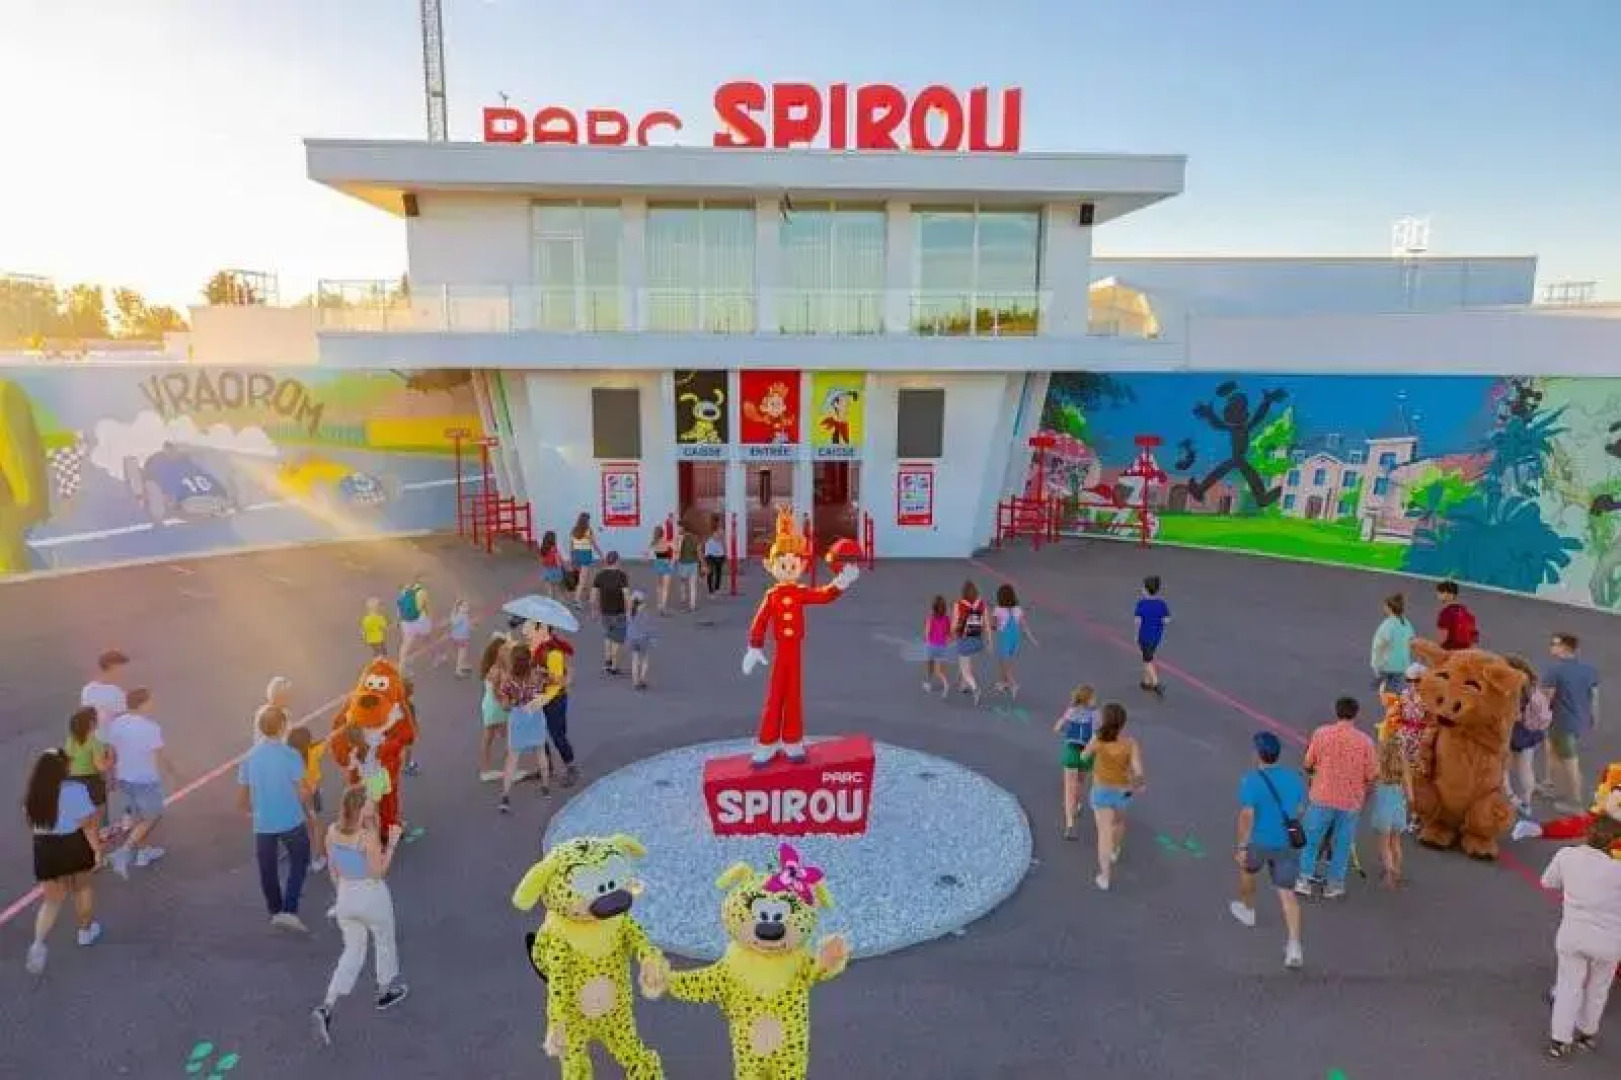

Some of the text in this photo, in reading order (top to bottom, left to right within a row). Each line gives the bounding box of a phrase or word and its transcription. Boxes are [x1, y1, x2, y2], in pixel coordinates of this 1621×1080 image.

[713, 80, 1022, 153] SPIROU
[822, 771, 863, 783] PARC
[716, 789, 864, 824] SPIROU
